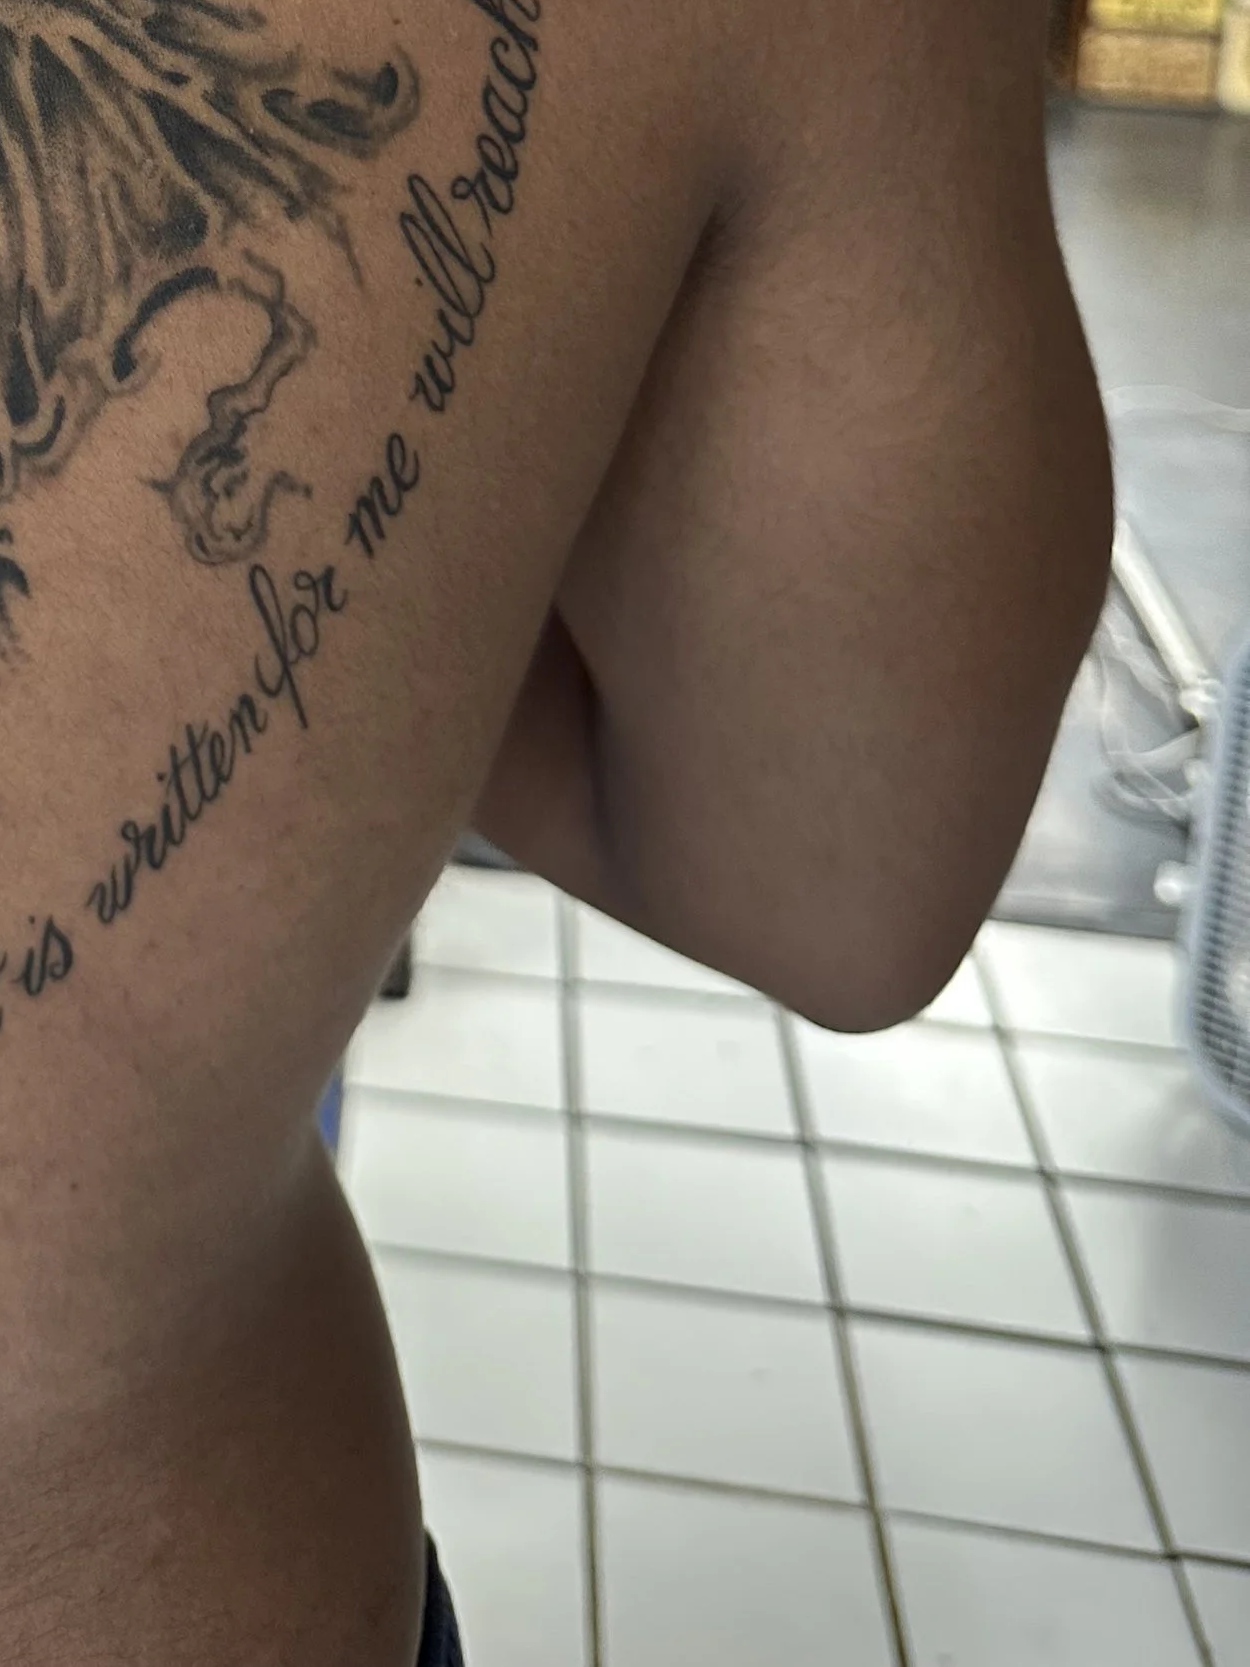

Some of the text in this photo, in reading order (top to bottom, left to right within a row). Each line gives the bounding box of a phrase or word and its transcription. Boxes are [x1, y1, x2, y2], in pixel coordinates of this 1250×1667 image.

[11, 914, 74, 997] is
[85, 693, 268, 925] written
[249, 563, 349, 730] for
[344, 432, 421, 559] me
[399, 173, 496, 412] will
